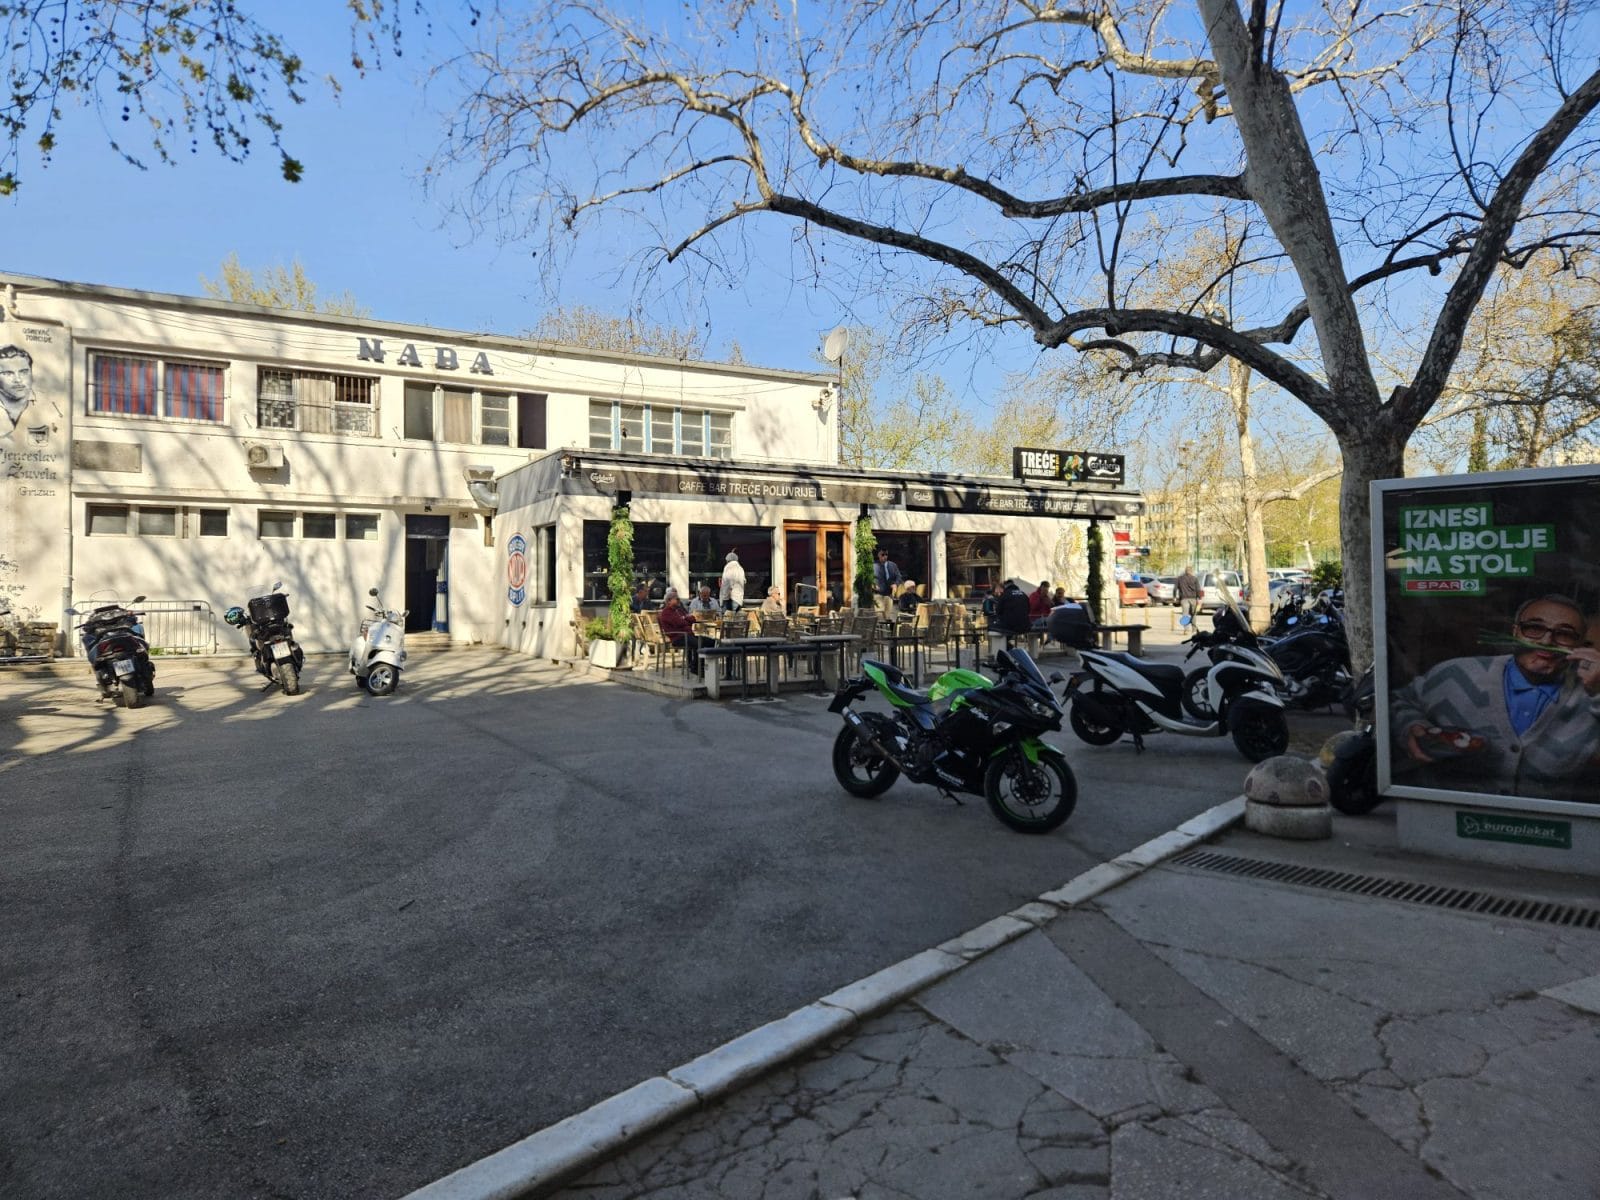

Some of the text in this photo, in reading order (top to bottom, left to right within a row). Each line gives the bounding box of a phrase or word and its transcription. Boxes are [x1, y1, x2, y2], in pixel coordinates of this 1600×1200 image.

[1020, 450, 1056, 469] TREĆE
[1087, 456, 1121, 476] Carlsberg
[709, 482, 727, 493] BAR
[729, 482, 761, 496] TREĆE
[1405, 507, 1487, 528] IZNESI
[1405, 528, 1548, 551] NAJBOLJE
[1406, 554, 1528, 574] NA STOL.
[1417, 581, 1461, 590] SPAR
[1484, 821, 1555, 838] europlakat
